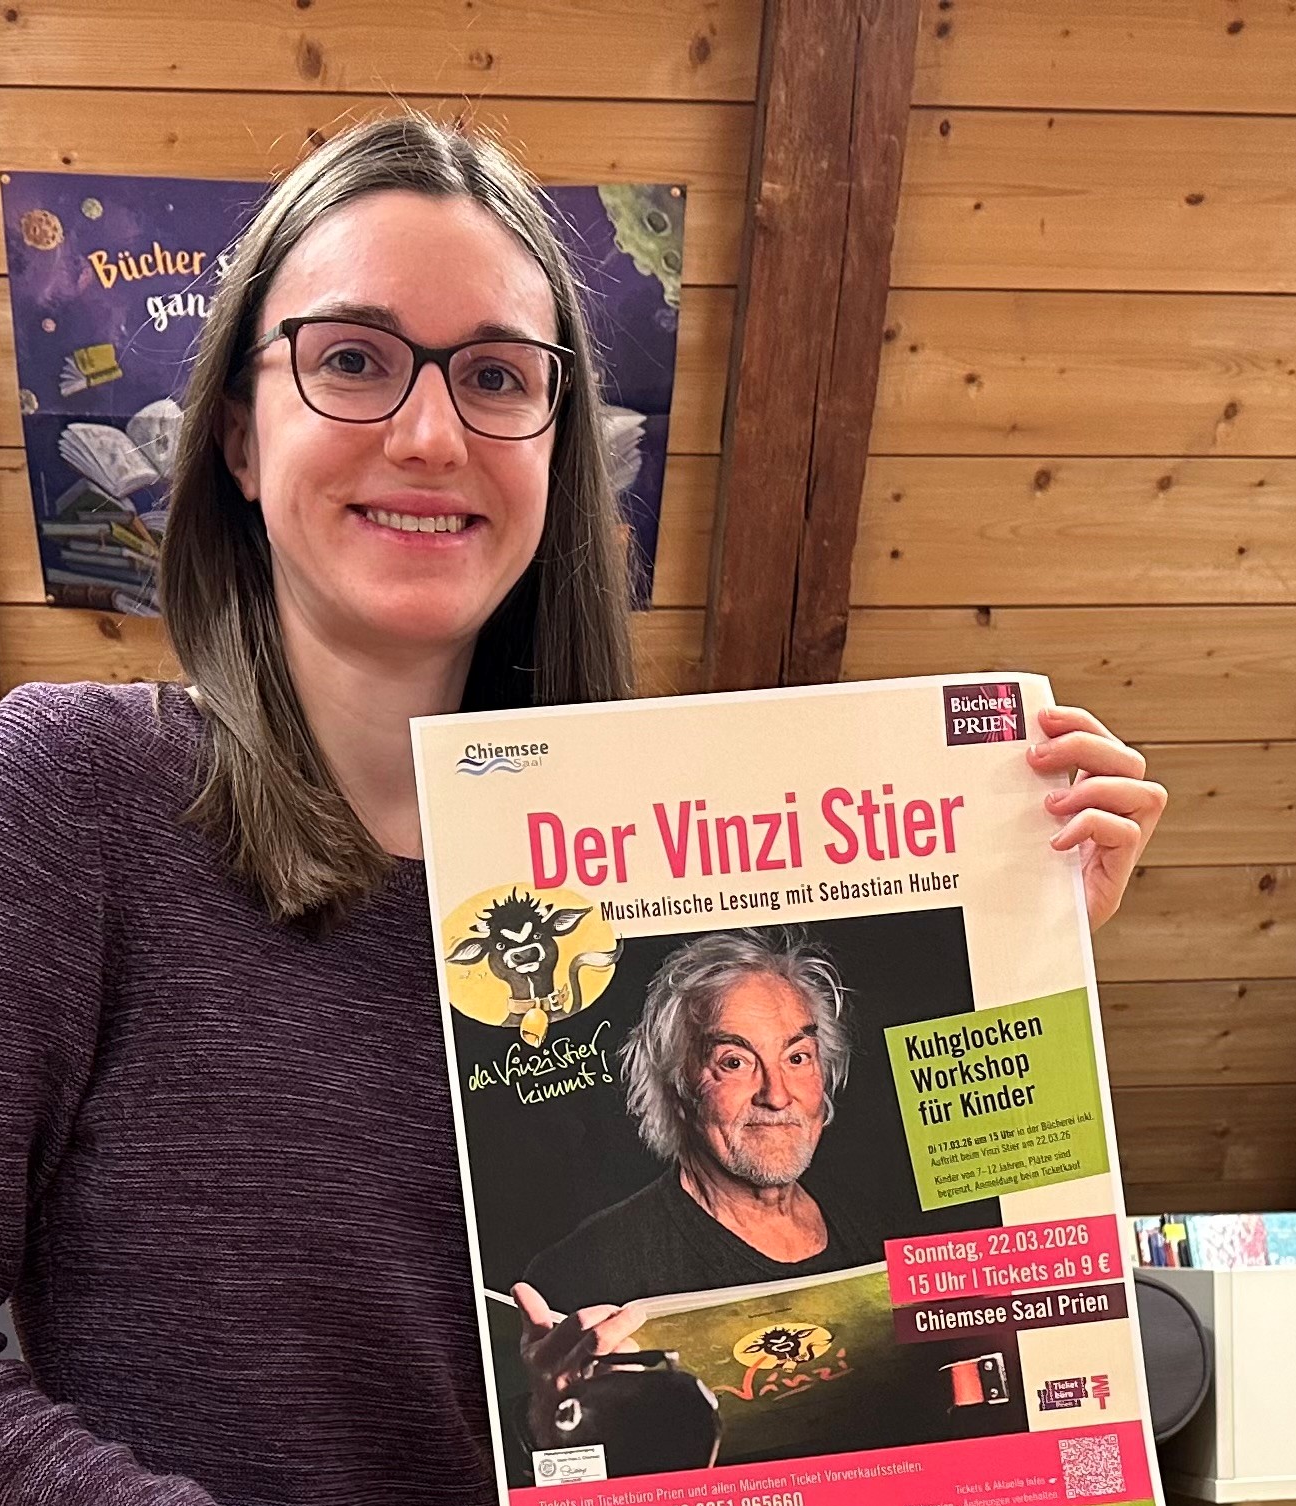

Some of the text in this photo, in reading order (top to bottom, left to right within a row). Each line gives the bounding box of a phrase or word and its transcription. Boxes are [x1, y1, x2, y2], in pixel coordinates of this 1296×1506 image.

[88, 241, 206, 289] Bücher
[950, 693, 1018, 713] Bücherei
[952, 714, 1019, 736] PRIEN
[465, 739, 549, 760] Chiemsee
[514, 756, 542, 768] Saal
[528, 784, 964, 890] Der Vinzi Stier
[600, 871, 960, 922] Musikalische Lesung mit Sebastian Huber
[905, 1016, 1043, 1061] Kuhglocken
[469, 1063, 498, 1091] da
[910, 1053, 1030, 1094] Workshop
[918, 1084, 1035, 1126] für Kinder
[938, 1136, 973, 1152] 17.03.26
[989, 1133, 999, 1142] 15
[1000, 1129, 1015, 1140] Uhr
[1041, 1118, 1075, 1131] Bücherei
[1036, 1130, 1071, 1145] 22.03.26
[1054, 1149, 1072, 1160] sind
[904, 1224, 1089, 1265] Sonntag, 22.03.2026
[908, 1253, 1110, 1296] 15 Uhr Tickets ab 9 €
[915, 1294, 1109, 1332] Chiemsee Saal Prien
[1053, 1380, 1079, 1390] Ticket
[597, 1491, 653, 1506] Ticketbüro
[656, 1488, 684, 1500] Prien
[688, 1483, 707, 1497] und
[711, 1479, 736, 1495] allen
[739, 1476, 787, 1492] München
[790, 1472, 822, 1486] Ticket
[955, 1483, 983, 1495] Tickets
[985, 1482, 991, 1491] &
